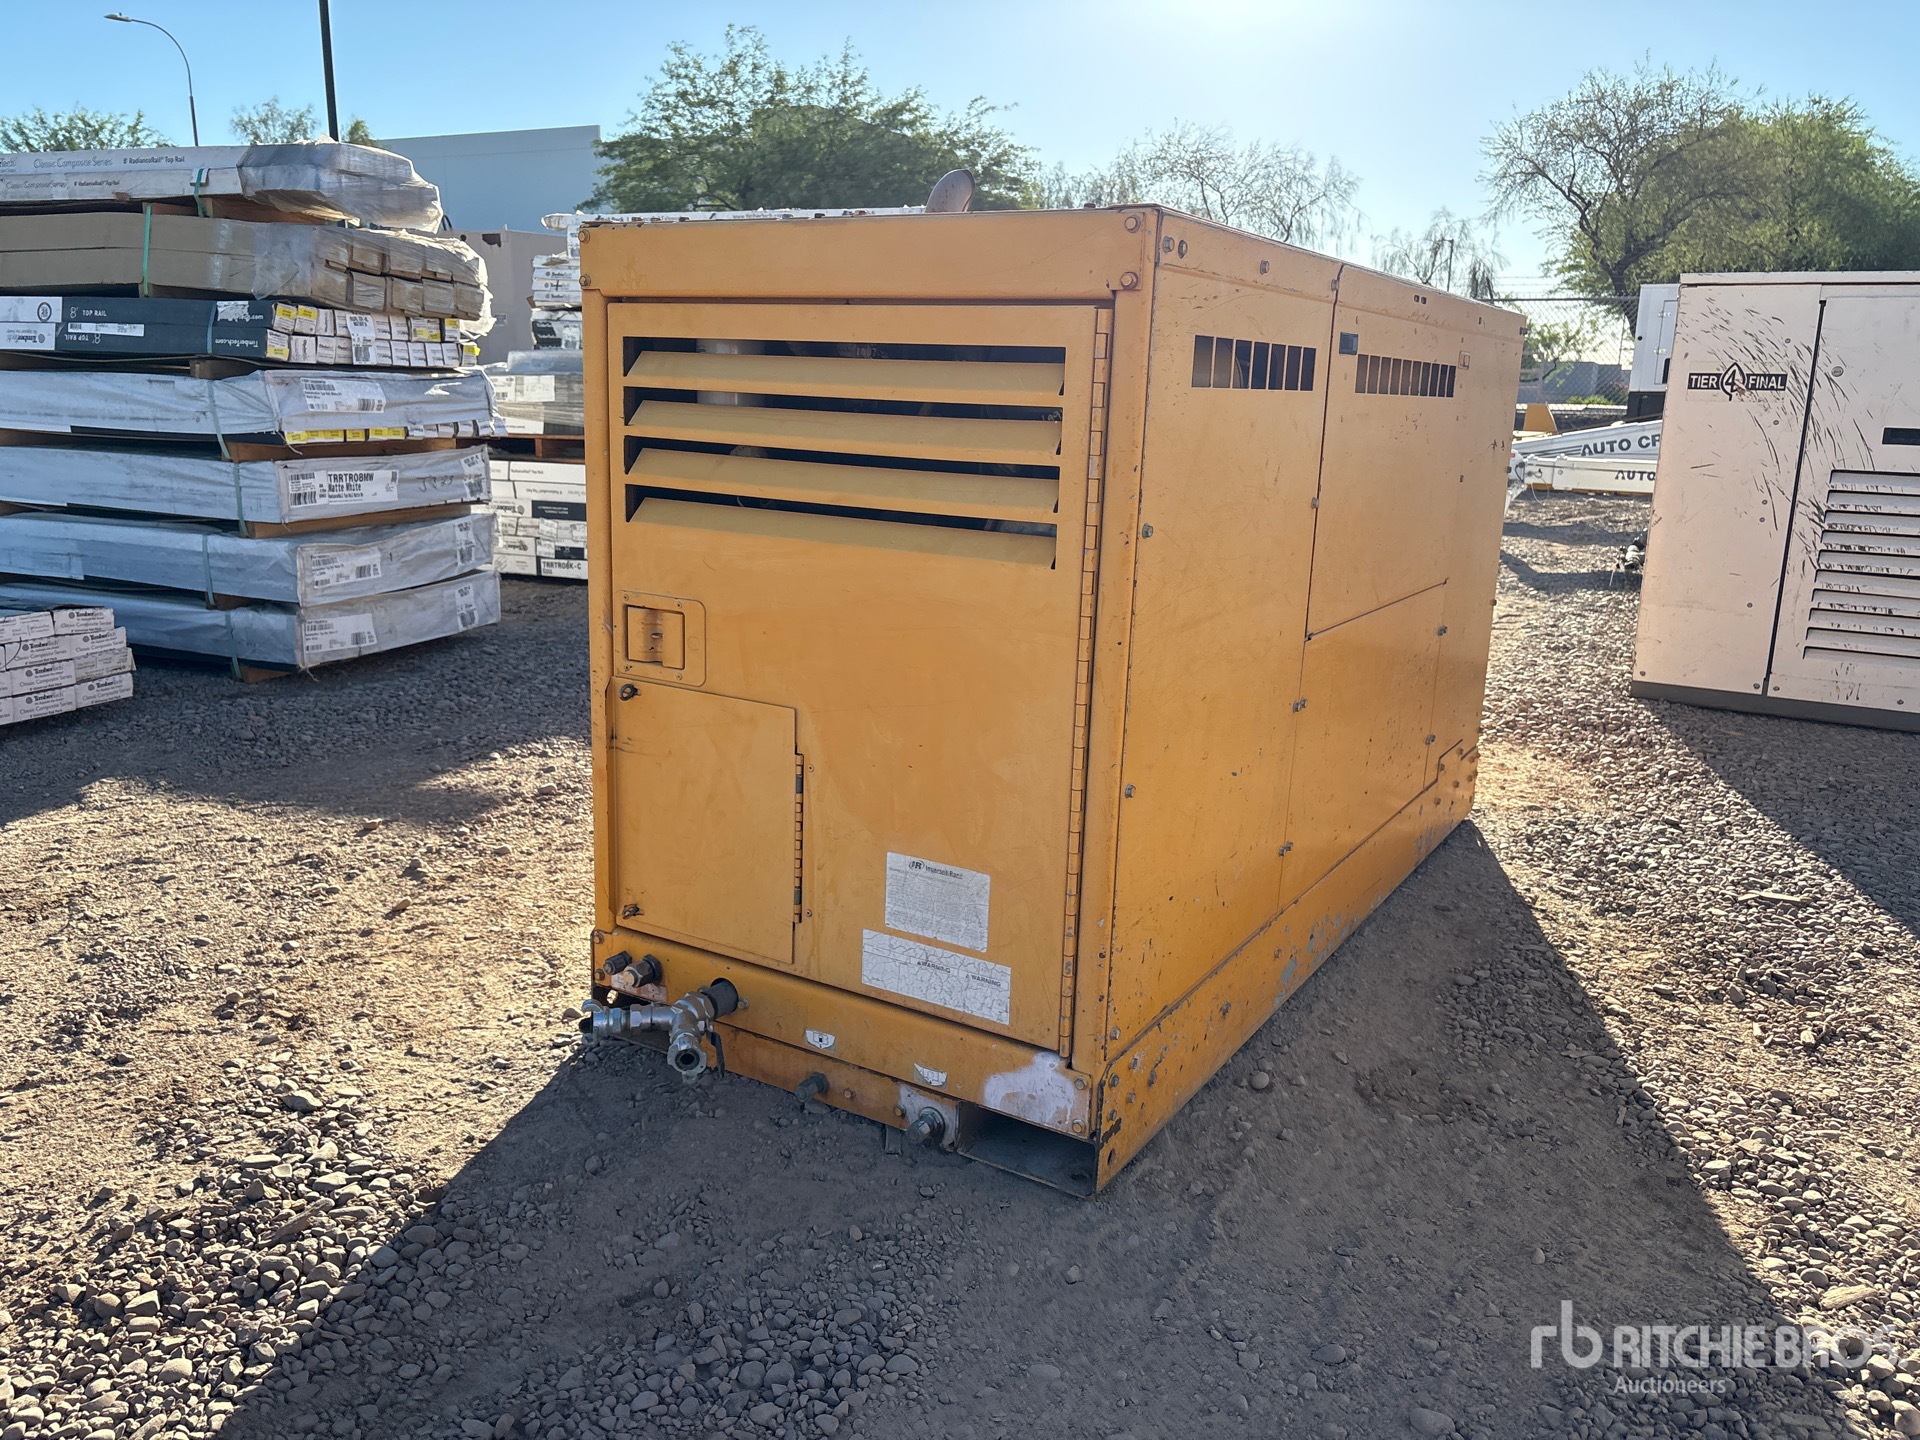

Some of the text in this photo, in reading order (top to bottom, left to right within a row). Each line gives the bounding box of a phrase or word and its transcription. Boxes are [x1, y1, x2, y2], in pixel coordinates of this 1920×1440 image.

[91, 155, 113, 167] Series
[82, 309, 94, 317] TOP
[94, 309, 107, 317] RAIL
[1690, 375, 1718, 388] TIER
[1748, 375, 1786, 389] FINAL
[1581, 433, 1661, 457] AUTO CR
[1615, 470, 1656, 481] AUTO
[328, 483, 345, 493] Matte
[345, 482, 362, 492] White
[920, 961, 951, 974] WARNING
[971, 974, 1001, 987] WARNING
